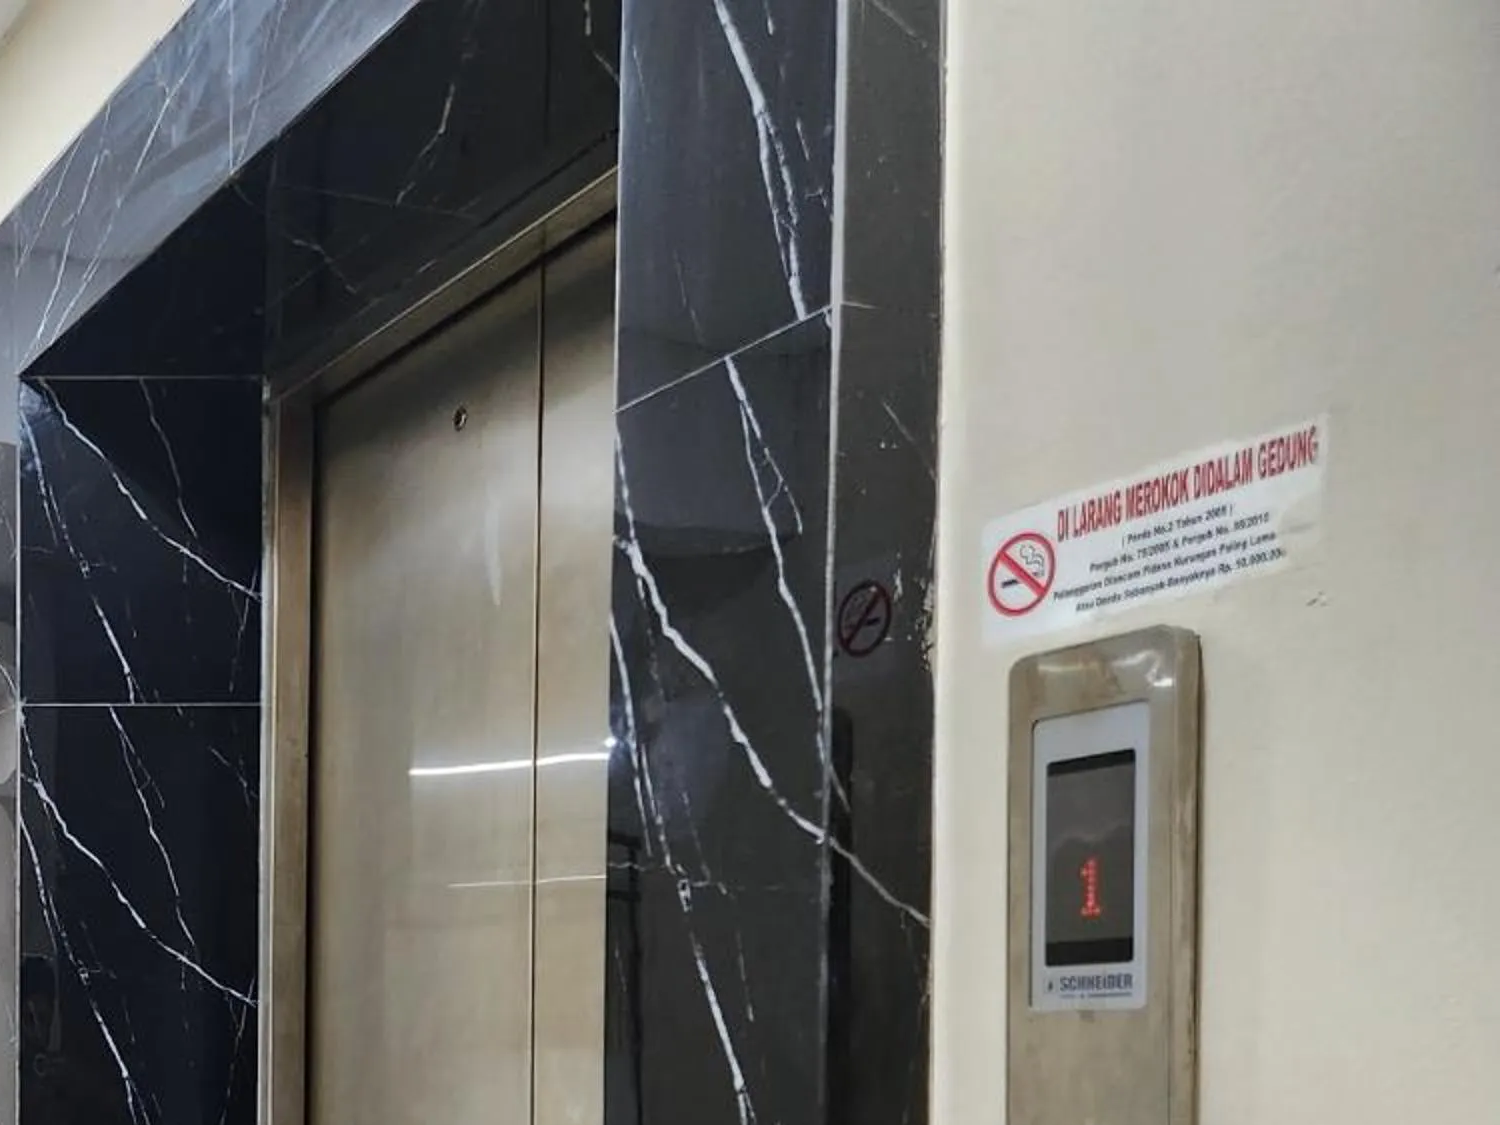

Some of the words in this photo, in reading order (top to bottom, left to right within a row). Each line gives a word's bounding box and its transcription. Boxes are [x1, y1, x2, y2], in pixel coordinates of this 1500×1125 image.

[1057, 509, 1069, 542] DI
[1073, 490, 1122, 537] LARANG
[1125, 468, 1190, 521] MEROKOK
[1193, 448, 1253, 500] DIDALAM
[1257, 425, 1319, 480] GEDUNG
[1175, 513, 1203, 529] Tahun
[1249, 531, 1276, 547] Lama
[1080, 857, 1102, 919] 1
[1059, 971, 1134, 992] SCHNEIDER
